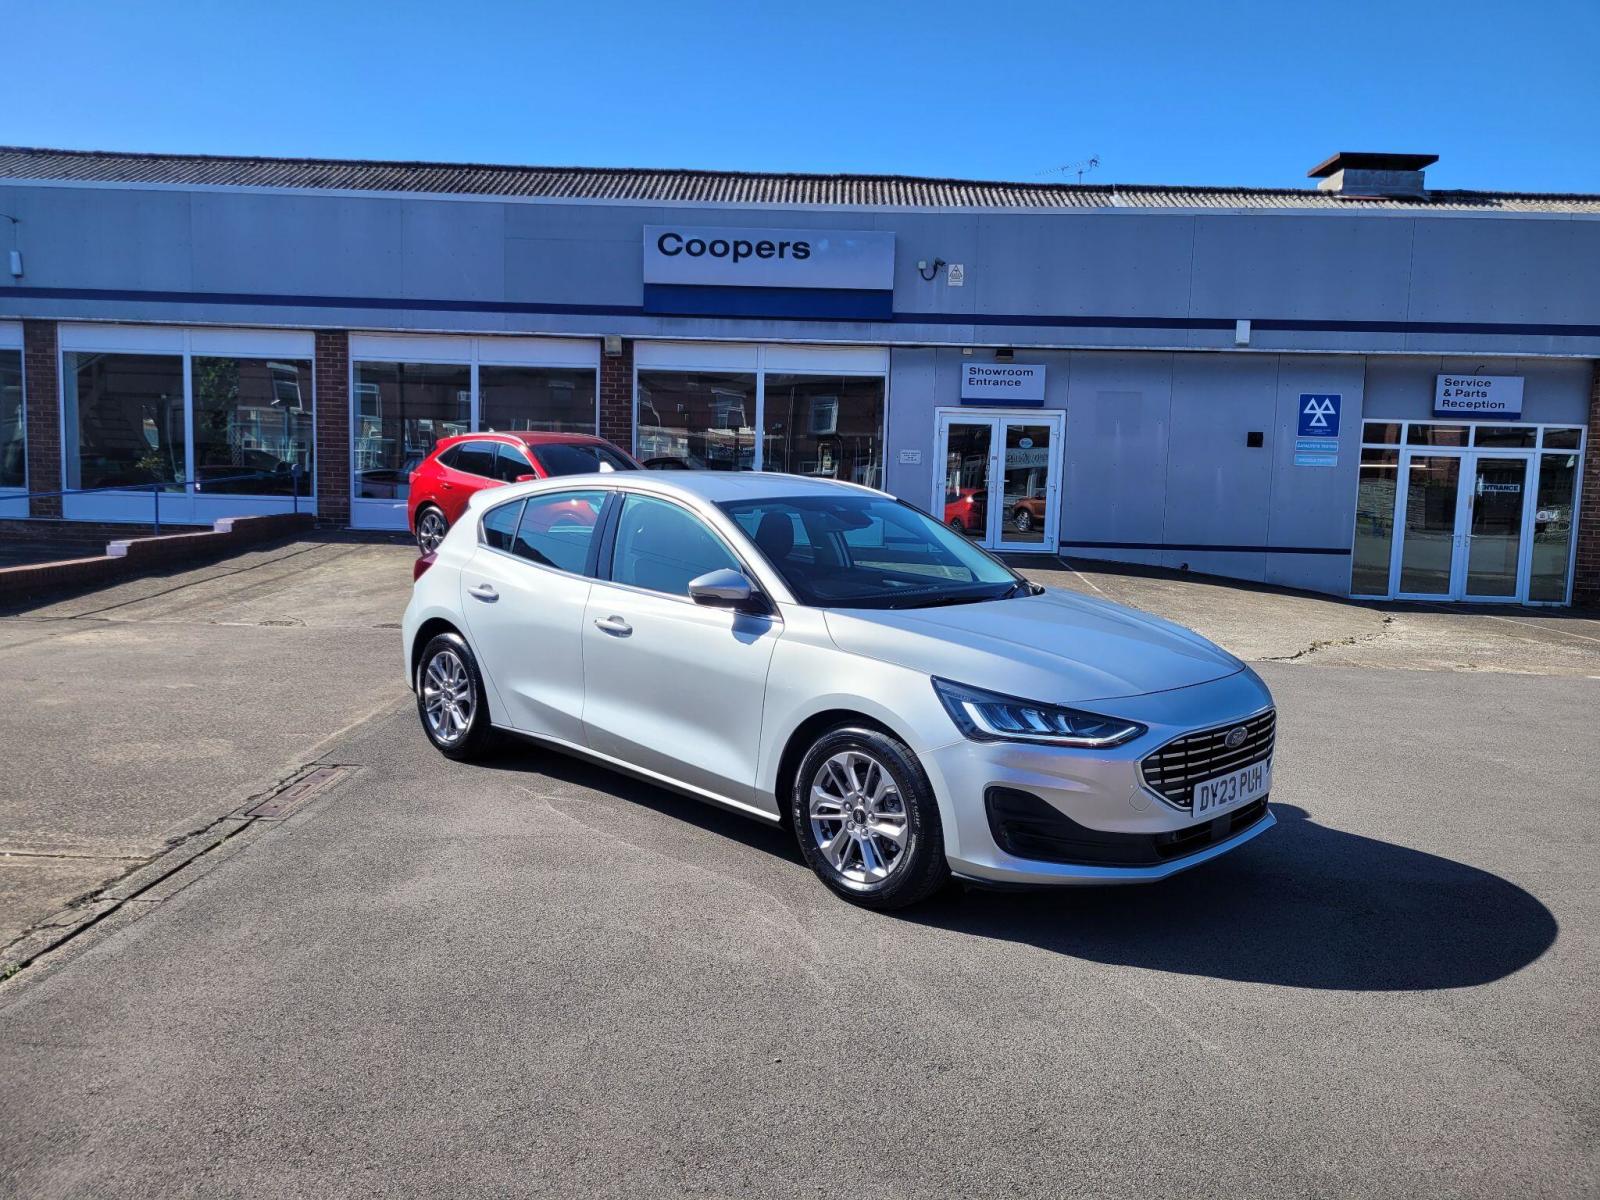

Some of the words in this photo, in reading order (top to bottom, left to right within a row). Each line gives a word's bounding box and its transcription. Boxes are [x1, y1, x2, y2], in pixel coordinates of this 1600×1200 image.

[657, 233, 811, 263] Coopers
[969, 367, 1034, 377] Showroom
[968, 377, 1022, 387] Entrance
[1444, 378, 1492, 387] Service
[1443, 389, 1452, 397] &
[1455, 389, 1488, 398] Parts
[1442, 400, 1506, 410] Reception
[1199, 776, 1237, 812] DY23
[1240, 765, 1263, 798] PUH
